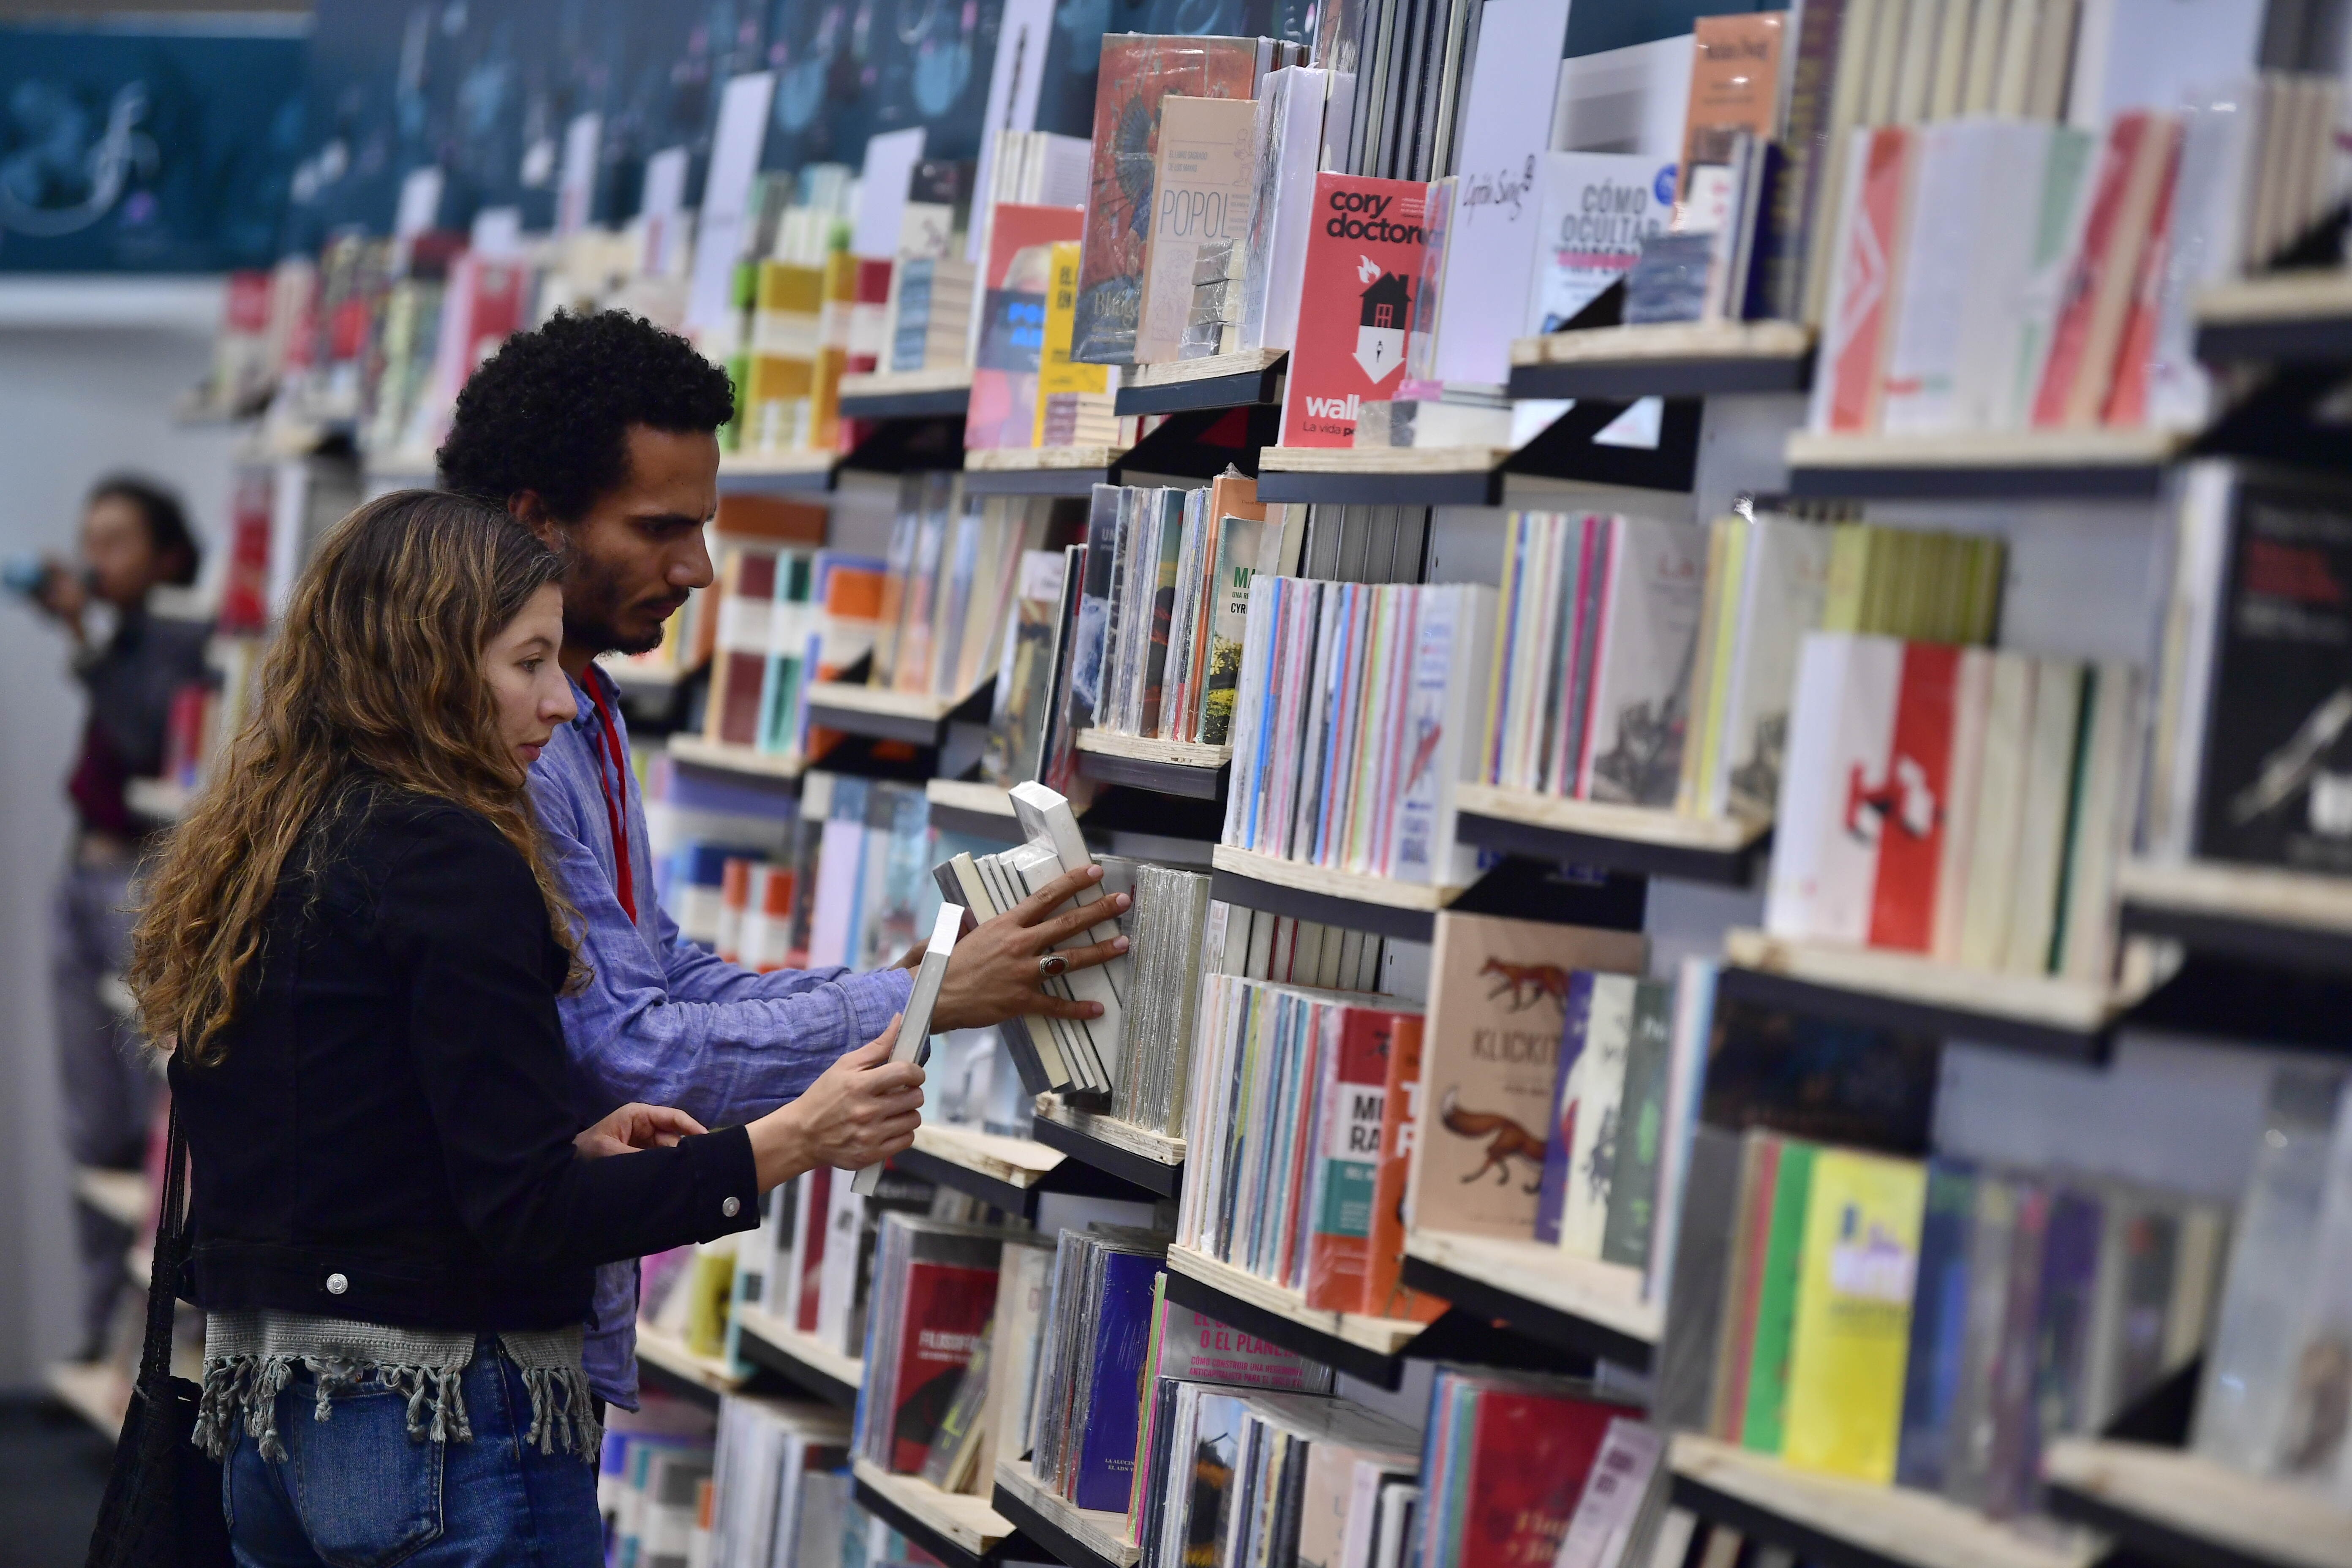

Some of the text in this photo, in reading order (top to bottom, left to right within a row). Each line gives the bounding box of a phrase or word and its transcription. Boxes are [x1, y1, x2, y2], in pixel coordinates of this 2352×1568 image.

[1160, 189, 1231, 238] POPOL
[1331, 191, 1393, 219] cory
[1303, 422, 1316, 432] La
[1320, 424, 1341, 434] vida
[1200, 1330, 1298, 1358] O EL PLANE
[1191, 1356, 1210, 1367] CÓMO
[1212, 1358, 1249, 1371] CONSTRUIR
[1250, 1363, 1263, 1372] UNA
[1189, 1367, 1242, 1381] ANTICAPITALISTA
[1244, 1373, 1260, 1383] PARA
[1262, 1376, 1269, 1384] EL
